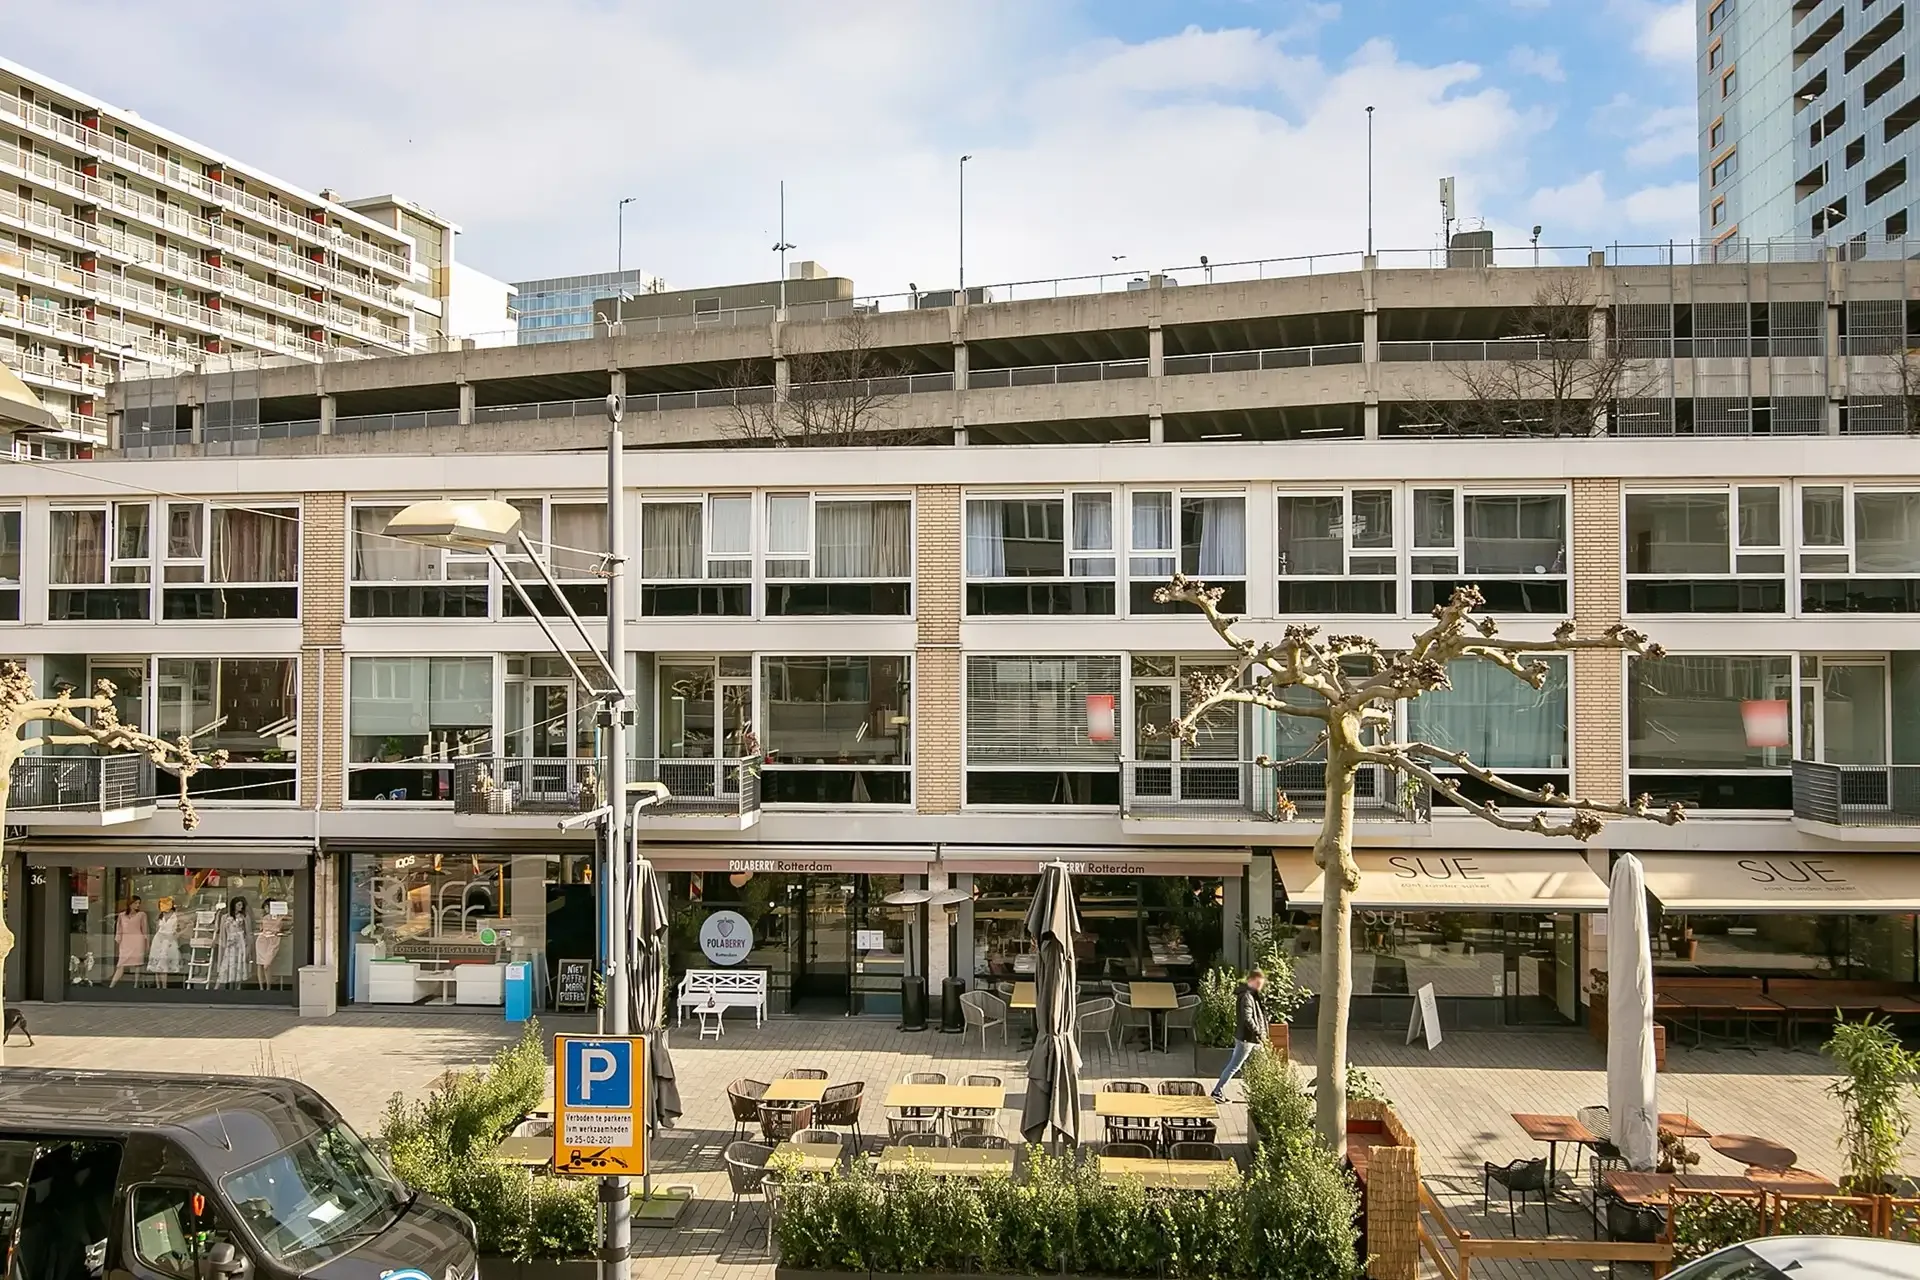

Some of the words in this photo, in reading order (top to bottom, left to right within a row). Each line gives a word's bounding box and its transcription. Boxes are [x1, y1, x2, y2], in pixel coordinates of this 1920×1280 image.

[395, 855, 415, 869] IQOS
[729, 859, 774, 871] POLABERRY
[777, 860, 833, 872] Rotterdam
[1038, 862, 1085, 873] PERRY
[1088, 863, 1145, 874] Rotterdam
[1388, 856, 1485, 880] SUE
[1737, 859, 1847, 882] SUE
[1361, 910, 1414, 925] SUE
[707, 938, 746, 948] POLABERRY
[567, 964, 584, 974] NIET
[581, 1048, 617, 1100] P
[566, 1113, 594, 1121] Verboden
[579, 1125, 628, 1133] werkzaamheden
[574, 1135, 614, 1144] 25-02-2021
